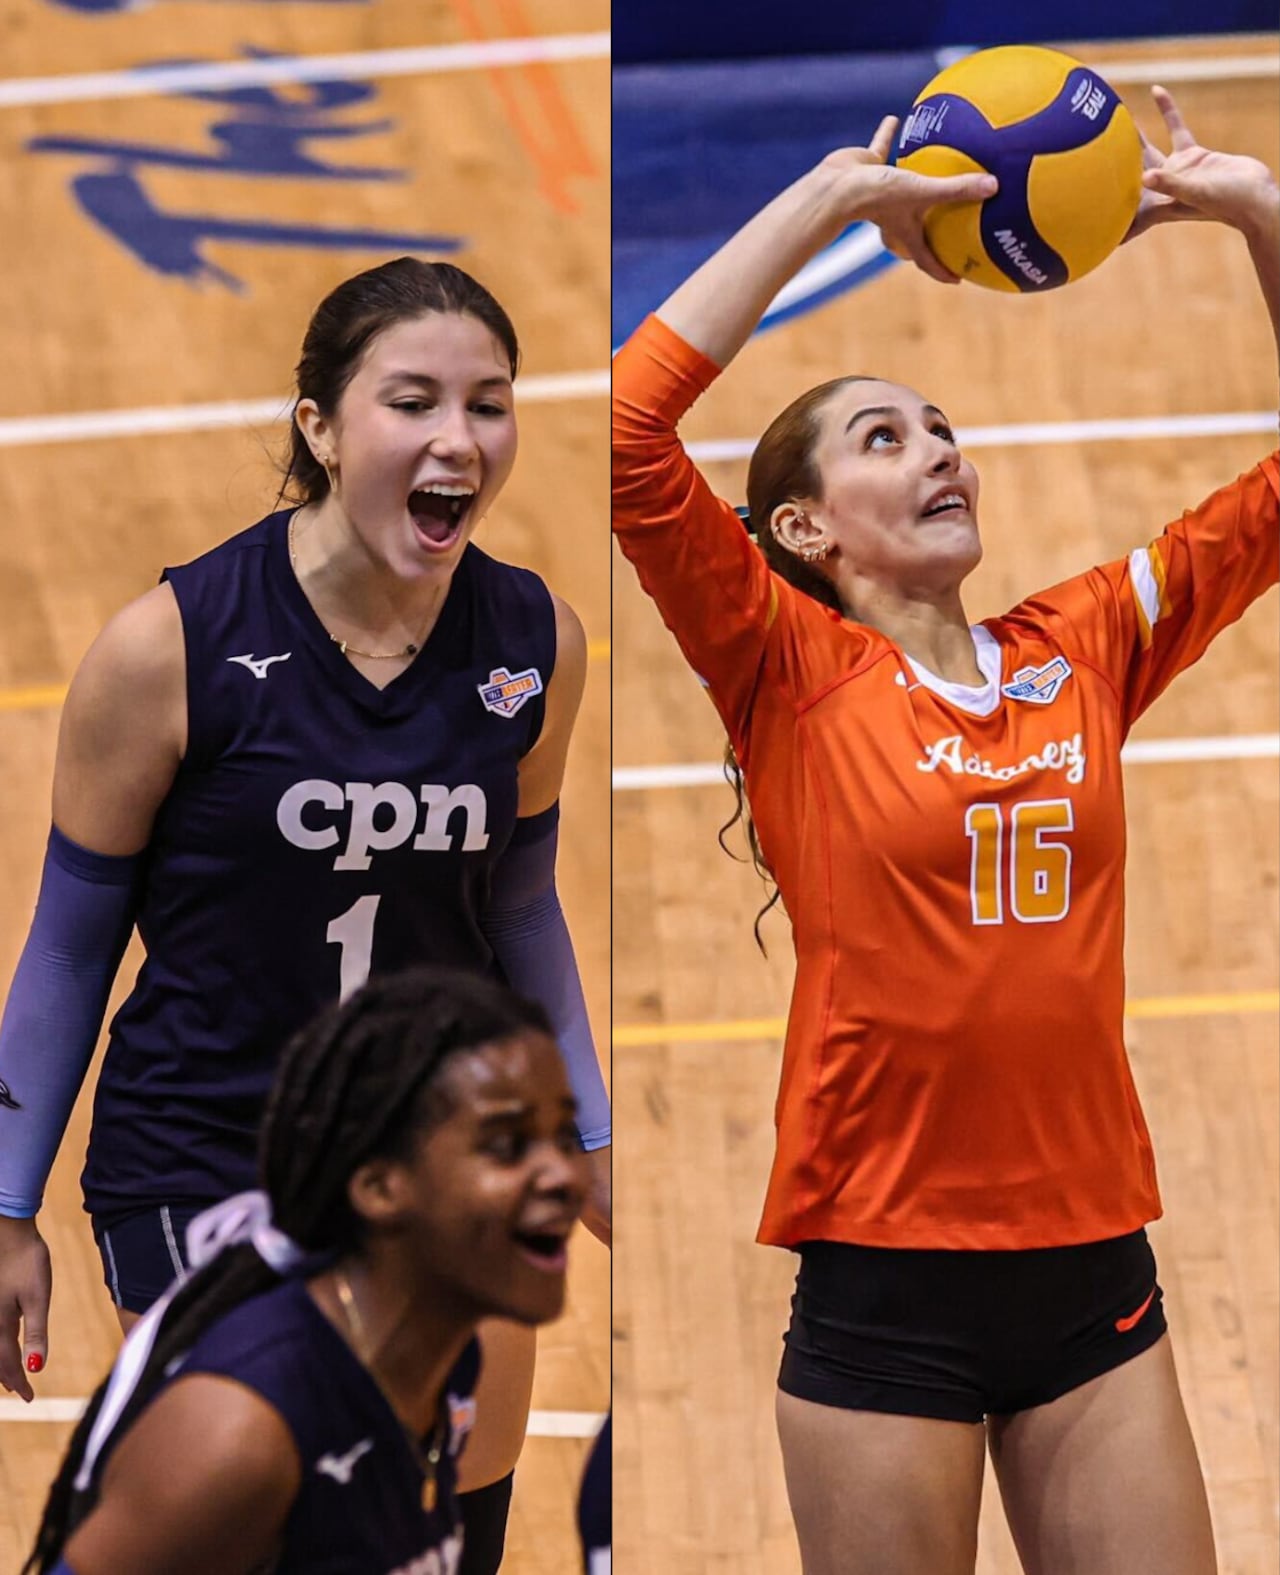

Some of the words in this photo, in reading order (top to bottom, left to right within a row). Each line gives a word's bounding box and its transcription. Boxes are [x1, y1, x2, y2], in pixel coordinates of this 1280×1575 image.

[276, 779, 489, 871] cpn
[965, 798, 1074, 925] 16
[326, 894, 381, 1005] 1
